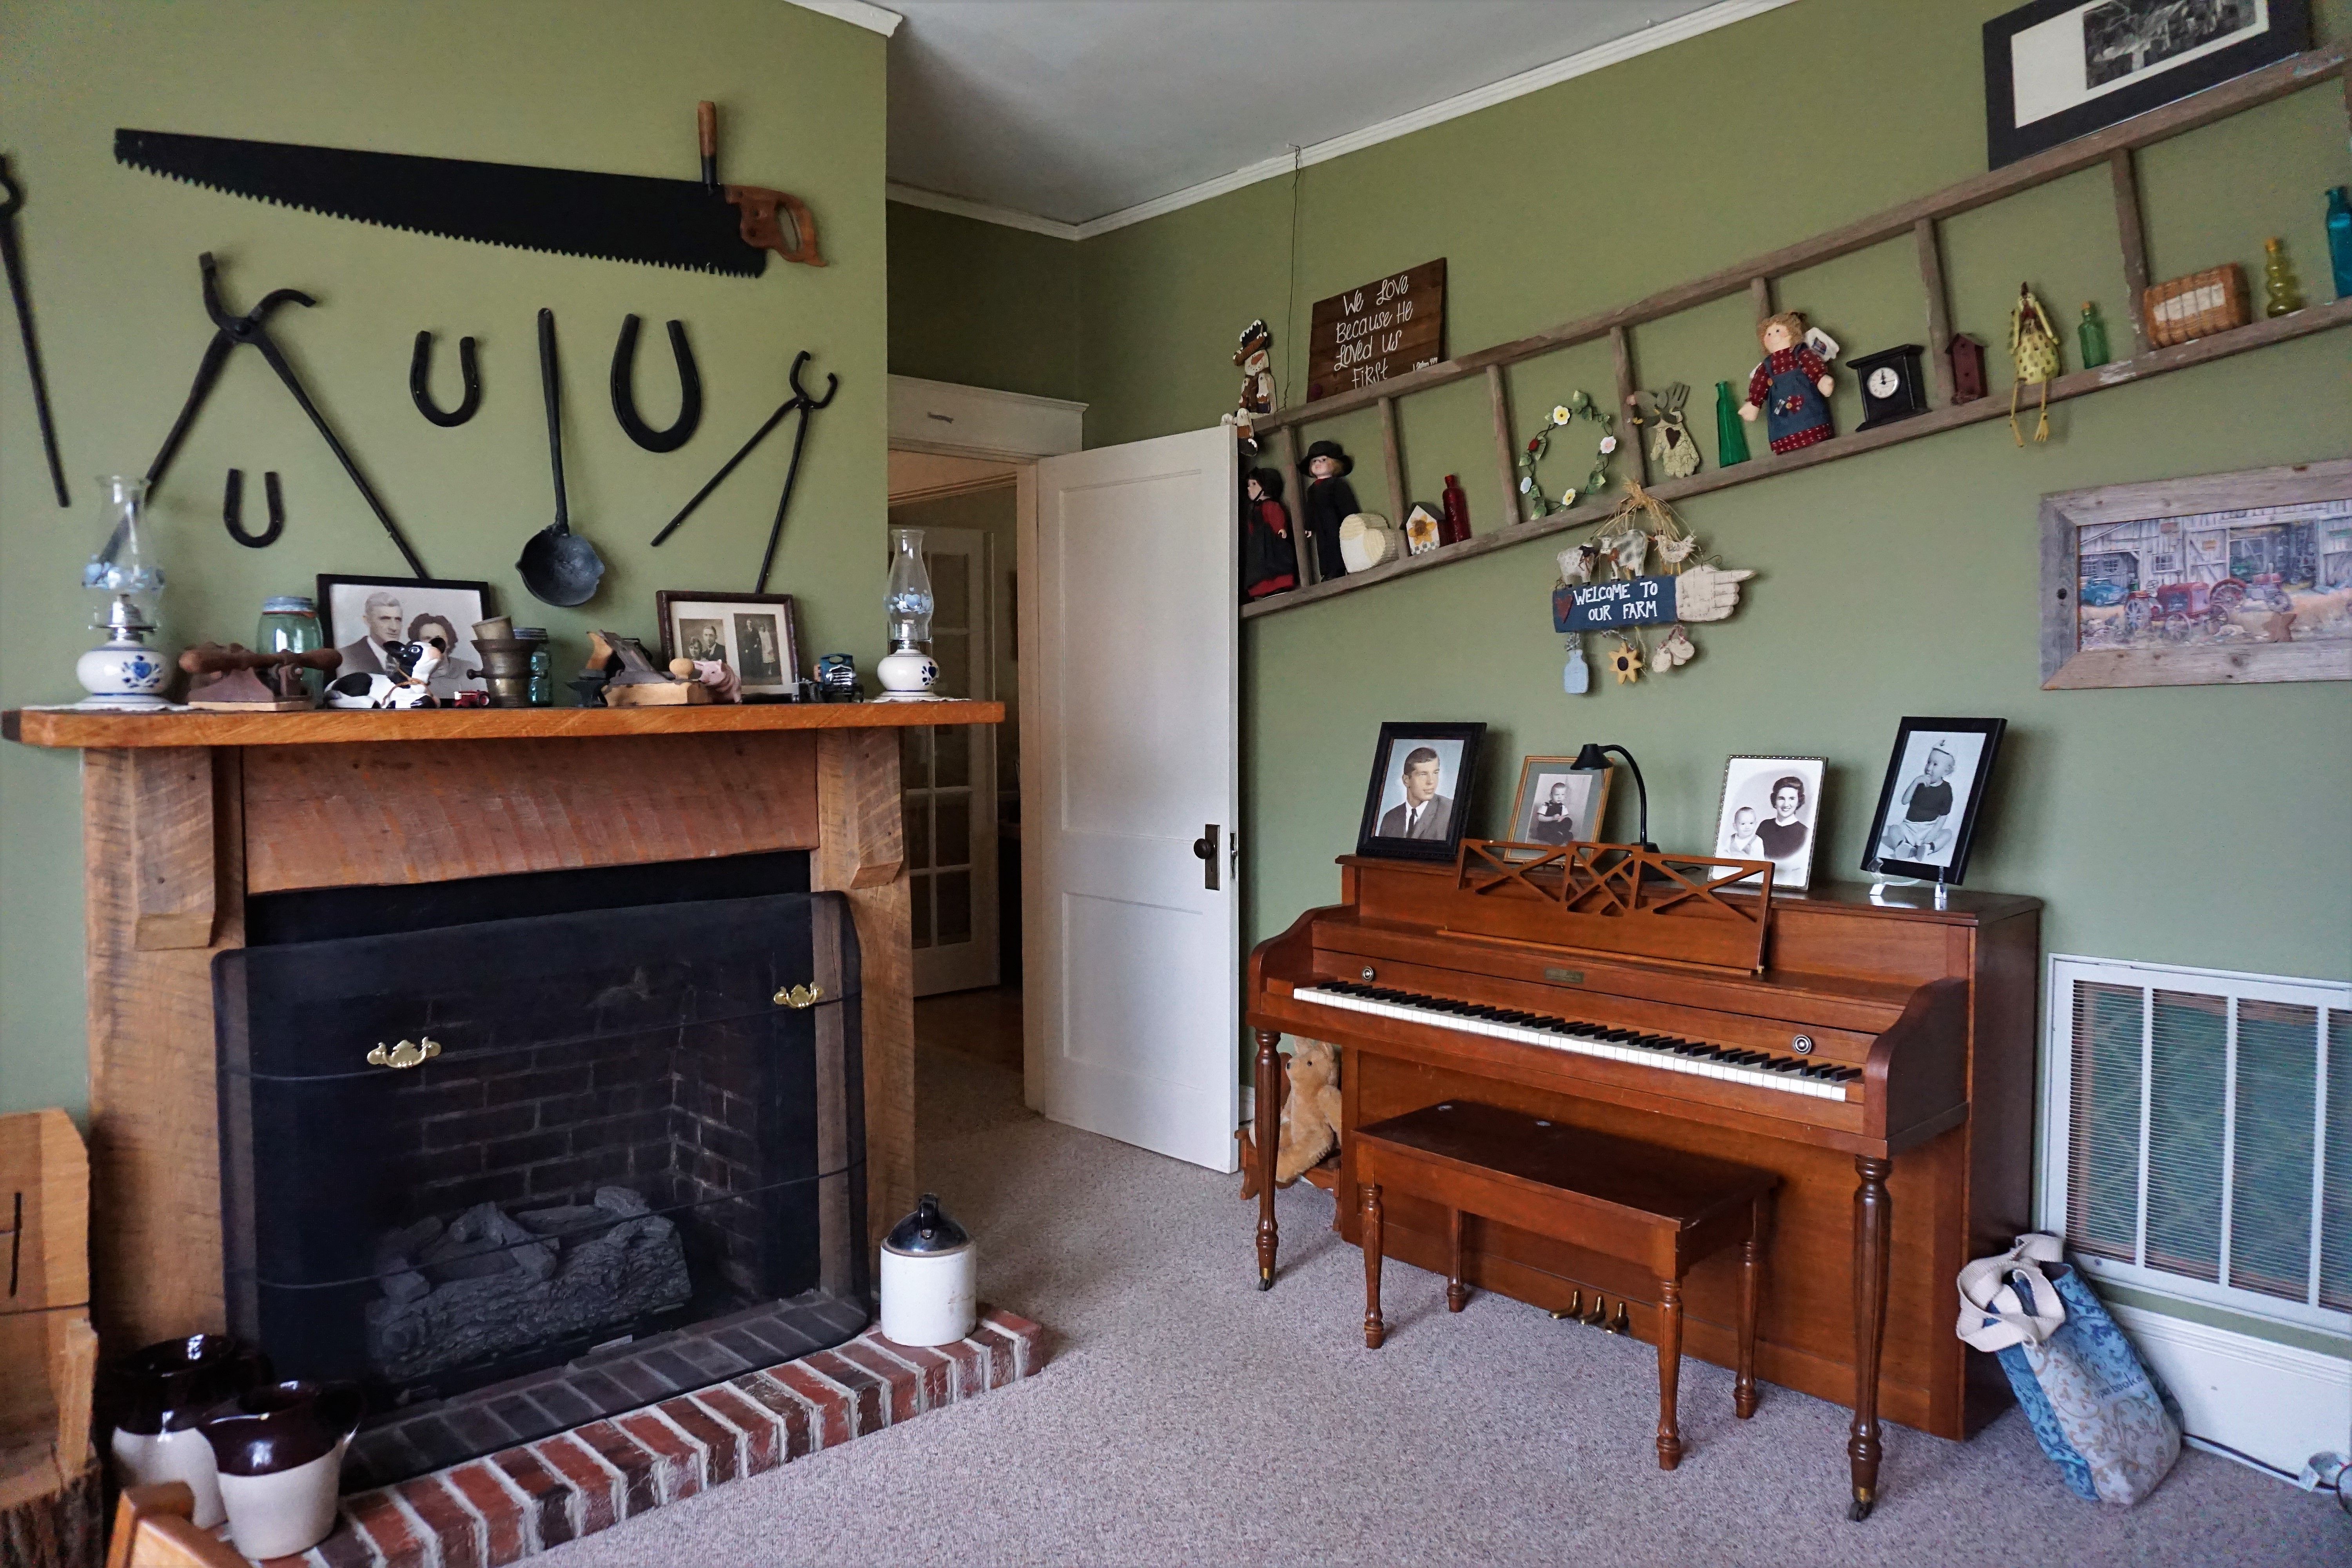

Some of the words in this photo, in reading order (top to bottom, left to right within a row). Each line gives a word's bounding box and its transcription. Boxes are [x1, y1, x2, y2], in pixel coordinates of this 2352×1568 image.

[1343, 289, 1364, 316] We
[1376, 275, 1409, 306] Love
[1336, 312, 1393, 343] Because
[1396, 301, 1414, 324] He
[1334, 336, 1372, 371] Loved
[1573, 583, 1631, 605] WELCOME
[1639, 581, 1659, 598] TO
[1588, 604, 1612, 621] OUR
[1623, 601, 1658, 619] FARM
